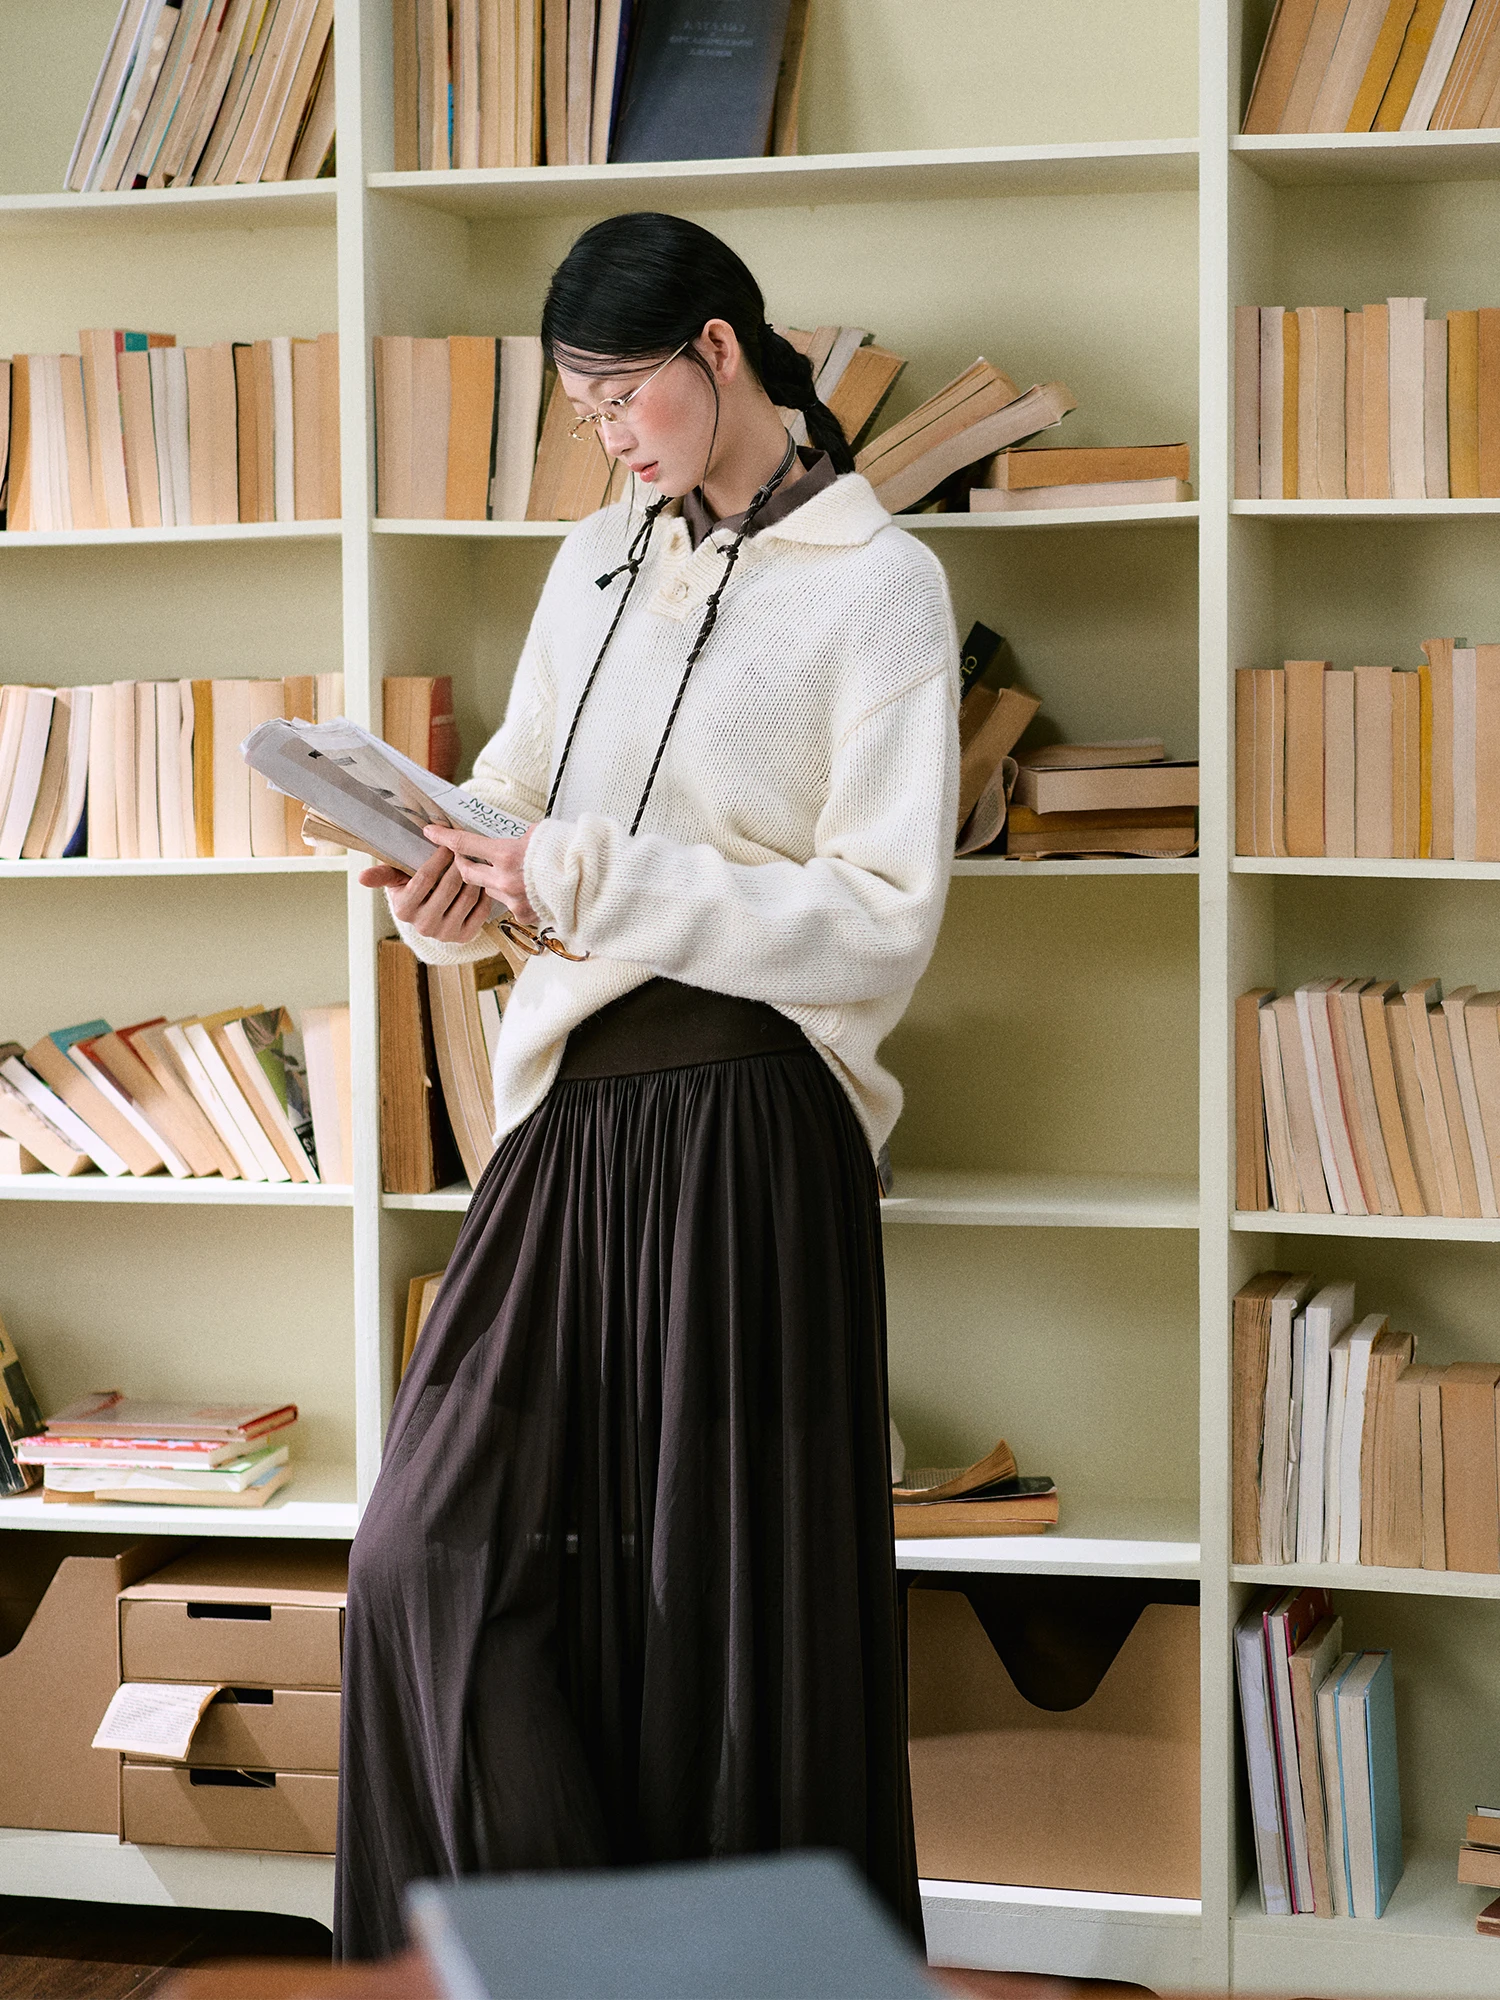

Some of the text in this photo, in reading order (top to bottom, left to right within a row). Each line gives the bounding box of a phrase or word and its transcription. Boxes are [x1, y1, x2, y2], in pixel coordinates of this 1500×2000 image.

[458, 799, 501, 827] THING
[502, 826, 521, 837] EV
[469, 797, 493, 815] NO
[494, 813, 526, 835] GOO
